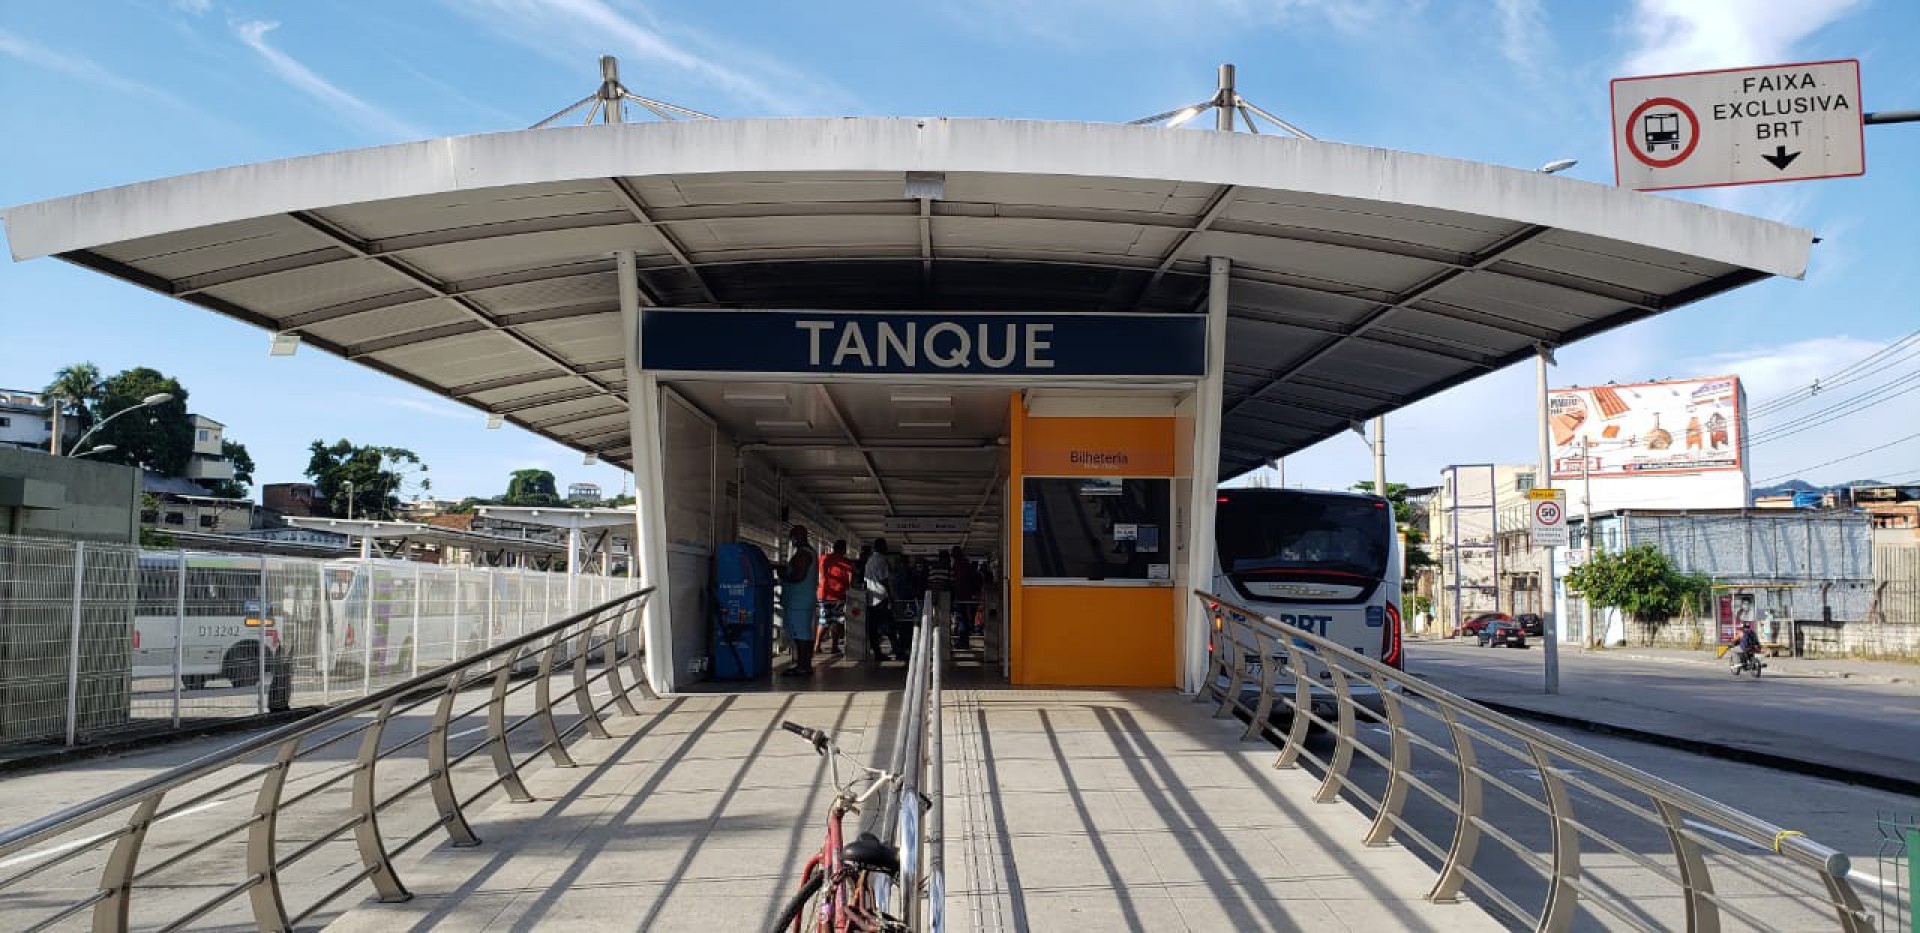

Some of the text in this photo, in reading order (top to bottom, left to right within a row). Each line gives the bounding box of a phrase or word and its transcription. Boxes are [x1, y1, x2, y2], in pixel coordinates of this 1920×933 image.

[1742, 72, 1816, 93] FAIXA
[1713, 94, 1849, 120] EXCLUSIVA
[1756, 121, 1803, 140] BRT
[795, 320, 1055, 368] TANQUE
[1070, 451, 1129, 465] Bilheteria
[1541, 507, 1556, 517] 50
